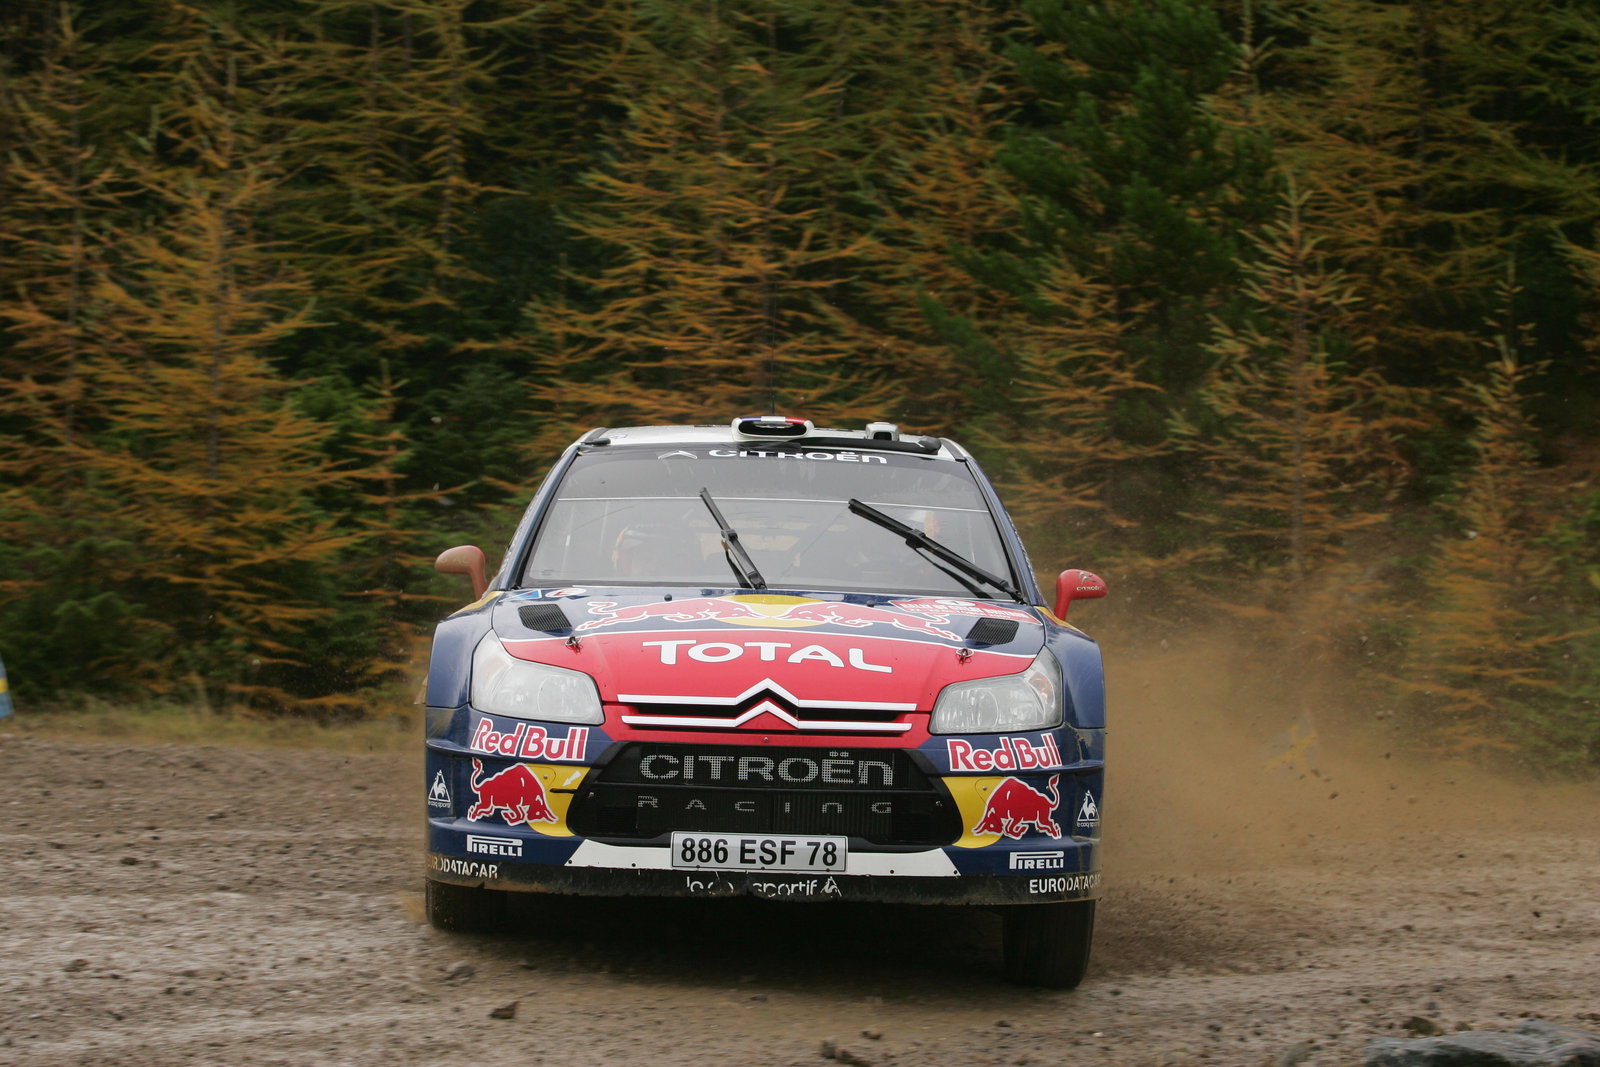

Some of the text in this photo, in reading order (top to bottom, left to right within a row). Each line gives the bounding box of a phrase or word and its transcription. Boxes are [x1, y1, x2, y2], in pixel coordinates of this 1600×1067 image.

[642, 639, 892, 673] TOTAL
[470, 717, 589, 761] Red Bull
[946, 732, 1062, 771] Red Bull
[466, 834, 523, 857] PIRELLI
[681, 837, 837, 867] 886 ESF 78
[1009, 850, 1064, 869] PIRELLI
